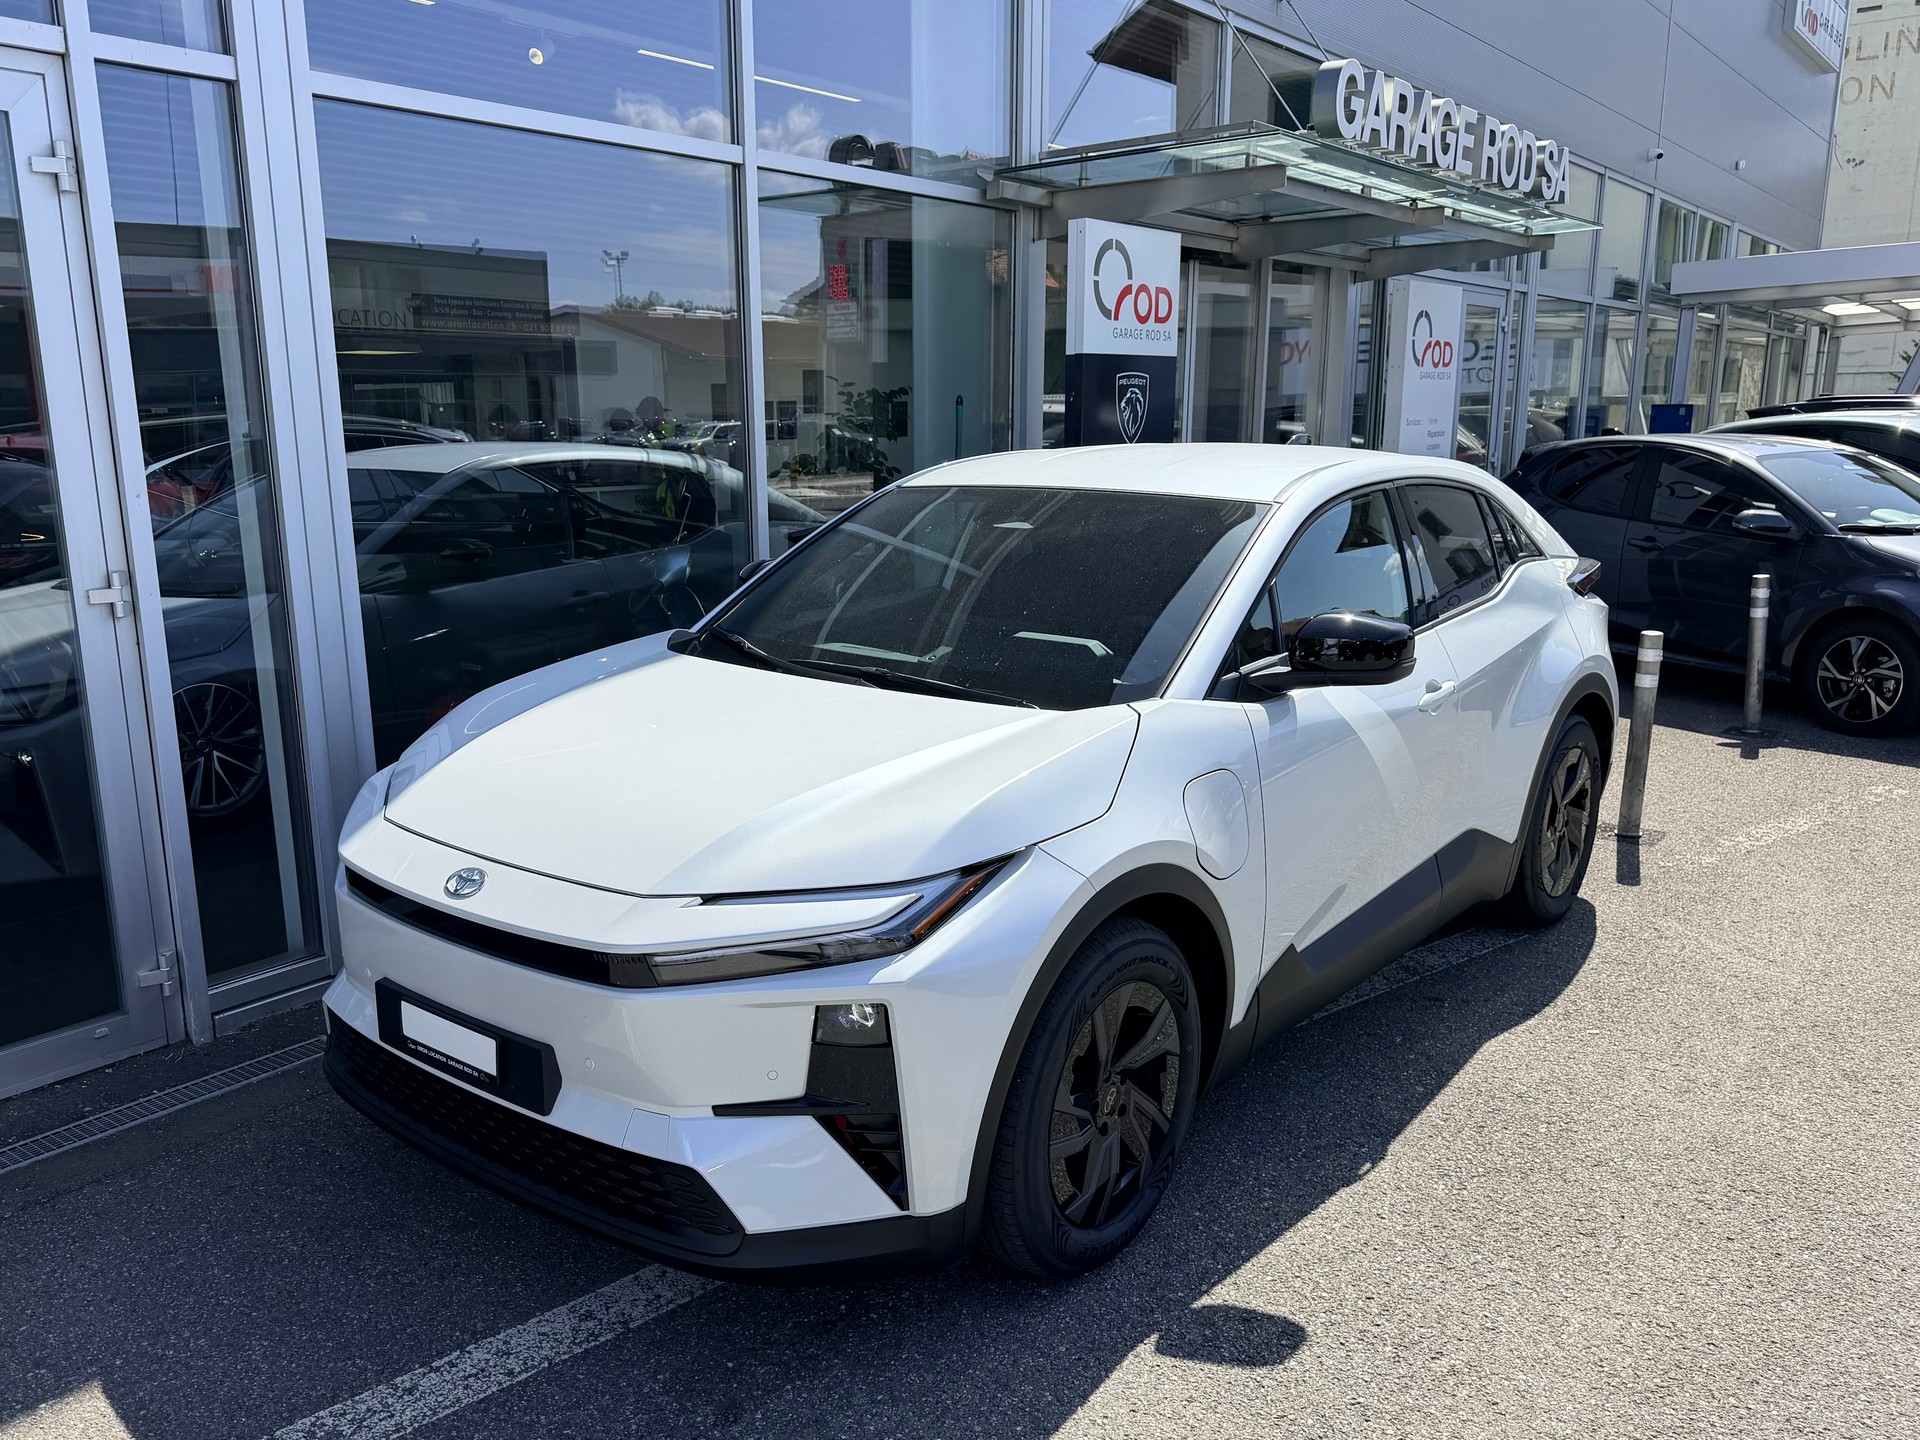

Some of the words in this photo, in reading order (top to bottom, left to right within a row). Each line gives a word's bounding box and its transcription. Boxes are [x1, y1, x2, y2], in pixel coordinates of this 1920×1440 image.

[1336, 58, 1478, 176] GARAGE
[1481, 115, 1538, 194] ROD
[1541, 139, 1569, 205] SA
[1112, 327, 1143, 340] GARAGE
[1145, 330, 1161, 341] ROD
[1162, 330, 1171, 341] SA
[1118, 377, 1147, 386] PEUGEOT
[1419, 371, 1436, 380] GARAGE
[1437, 371, 1446, 380] ROD
[1446, 371, 1452, 380] SA
[428, 1050, 447, 1063] LOCATION
